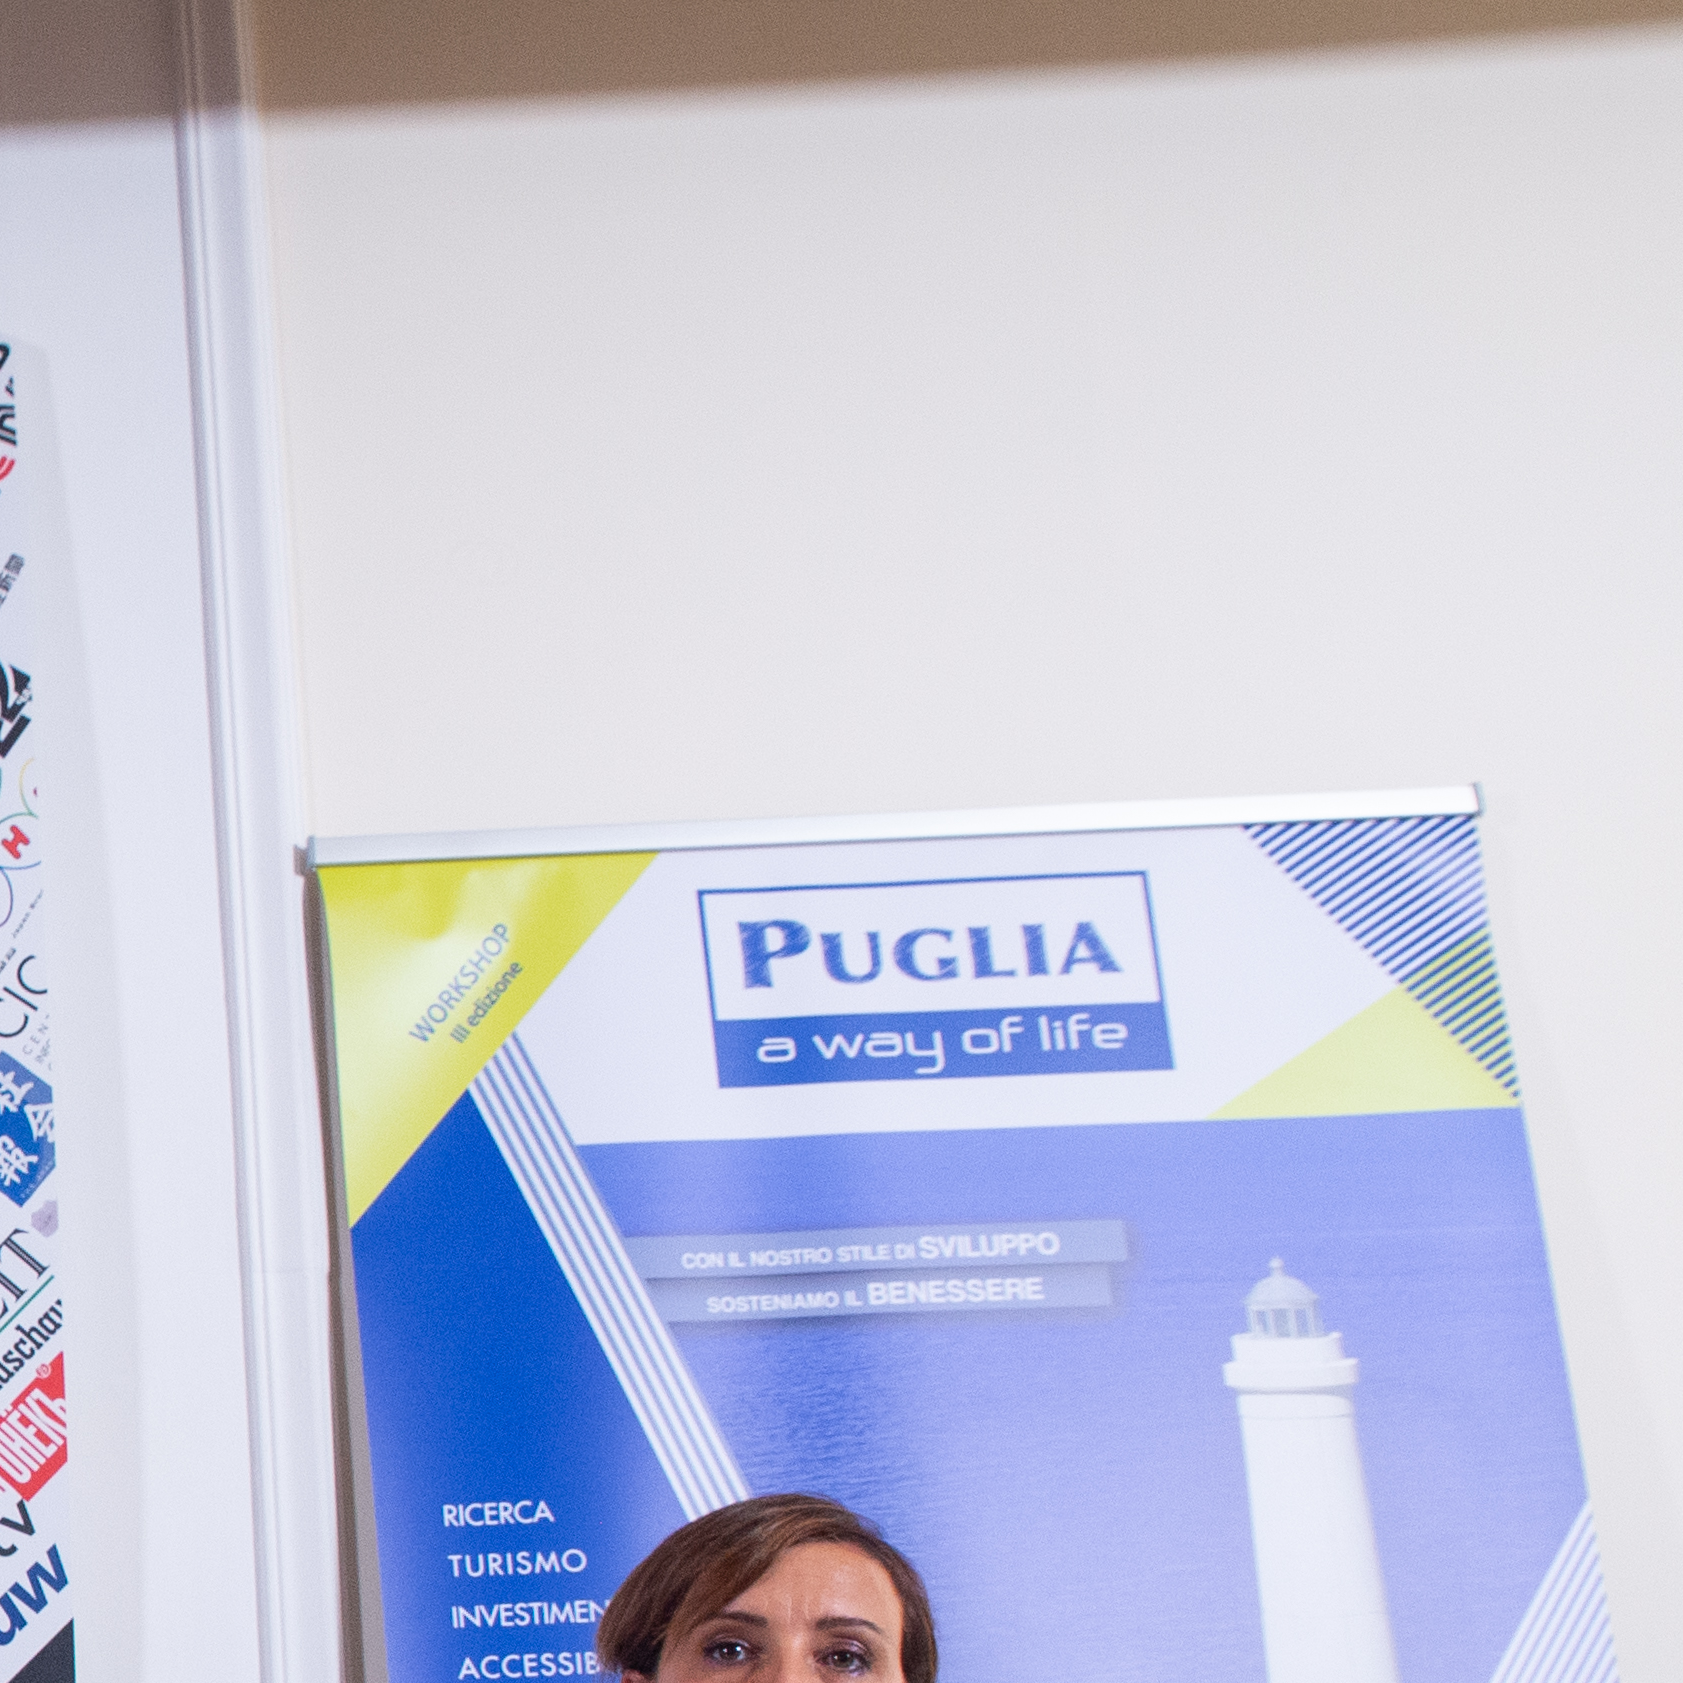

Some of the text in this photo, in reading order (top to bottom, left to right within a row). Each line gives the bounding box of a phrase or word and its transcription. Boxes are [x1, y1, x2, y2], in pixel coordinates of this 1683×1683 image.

[736, 919, 1124, 989] PUGLIA
[409, 924, 508, 1041] WORKSHOP
[467, 962, 522, 1026] edizione
[757, 1012, 1128, 1074] a way of life
[681, 1232, 1060, 1269] CON IL NOSTRO STILE DI SVILUPPO
[706, 1278, 1043, 1314] SOSTENIAMO IL BENESSERE
[442, 1500, 555, 1527] RICERCA
[447, 1549, 587, 1578] TURISMO
[451, 1600, 610, 1628] INVESTIMEN
